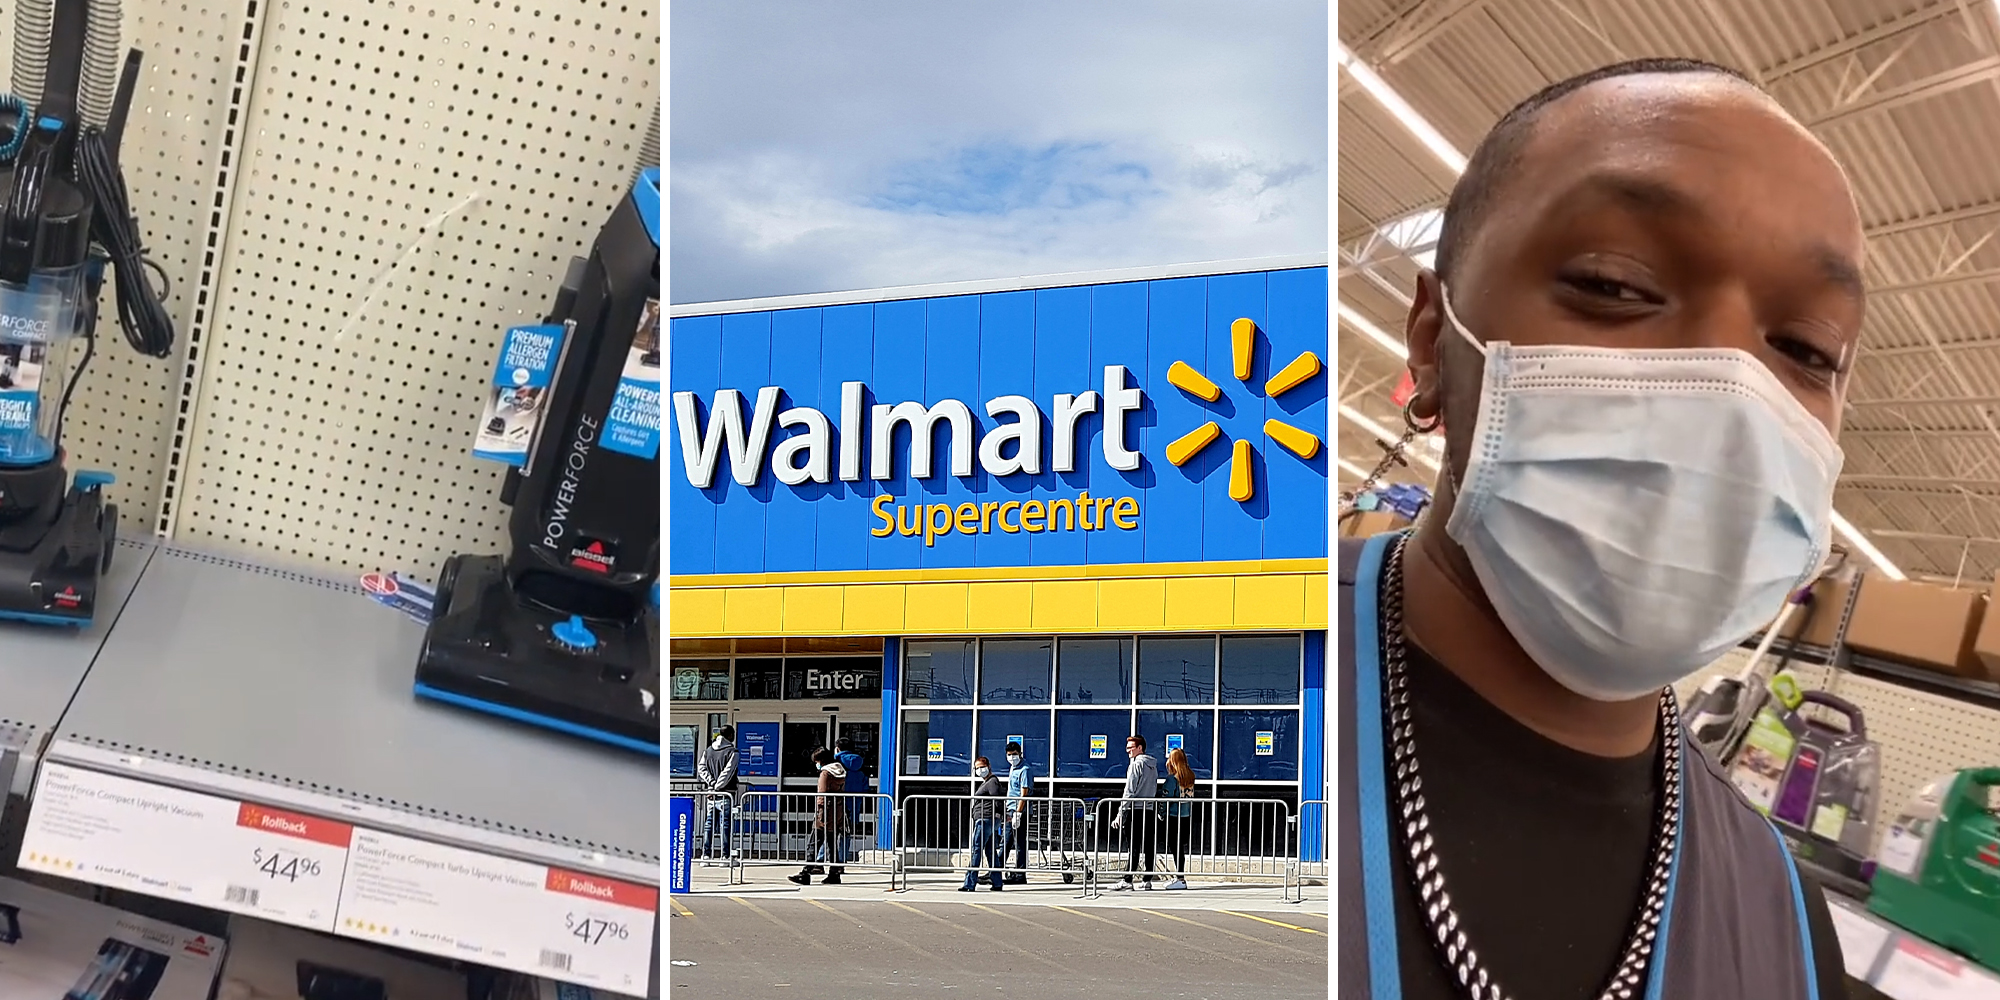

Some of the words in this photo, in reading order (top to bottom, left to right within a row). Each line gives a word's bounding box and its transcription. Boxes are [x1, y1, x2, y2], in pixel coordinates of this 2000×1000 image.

[0, 313, 49, 332] RFORCE
[510, 329, 554, 349] PREMIUM
[504, 353, 547, 371] FILTRATION
[507, 342, 550, 361] ALLERGEN
[610, 406, 660, 431] CLEANING
[673, 365, 1142, 488] Walmart
[543, 413, 598, 549] POWERFORCE
[871, 491, 1140, 546] Supercentre
[807, 669, 863, 689] Enter
[46, 779, 95, 797] PowerForce
[97, 789, 135, 806] Compact
[137, 798, 168, 813] Upright
[171, 806, 204, 819] Vacuum
[262, 815, 306, 834] Rollback
[678, 813, 686, 842] GRAND
[357, 844, 406, 861] PowerForce
[408, 855, 445, 870] Compact
[447, 863, 470, 875] Turbo
[472, 868, 502, 882] Upright
[504, 875, 537, 888] Vacuum
[569, 879, 614, 898] Rollback
